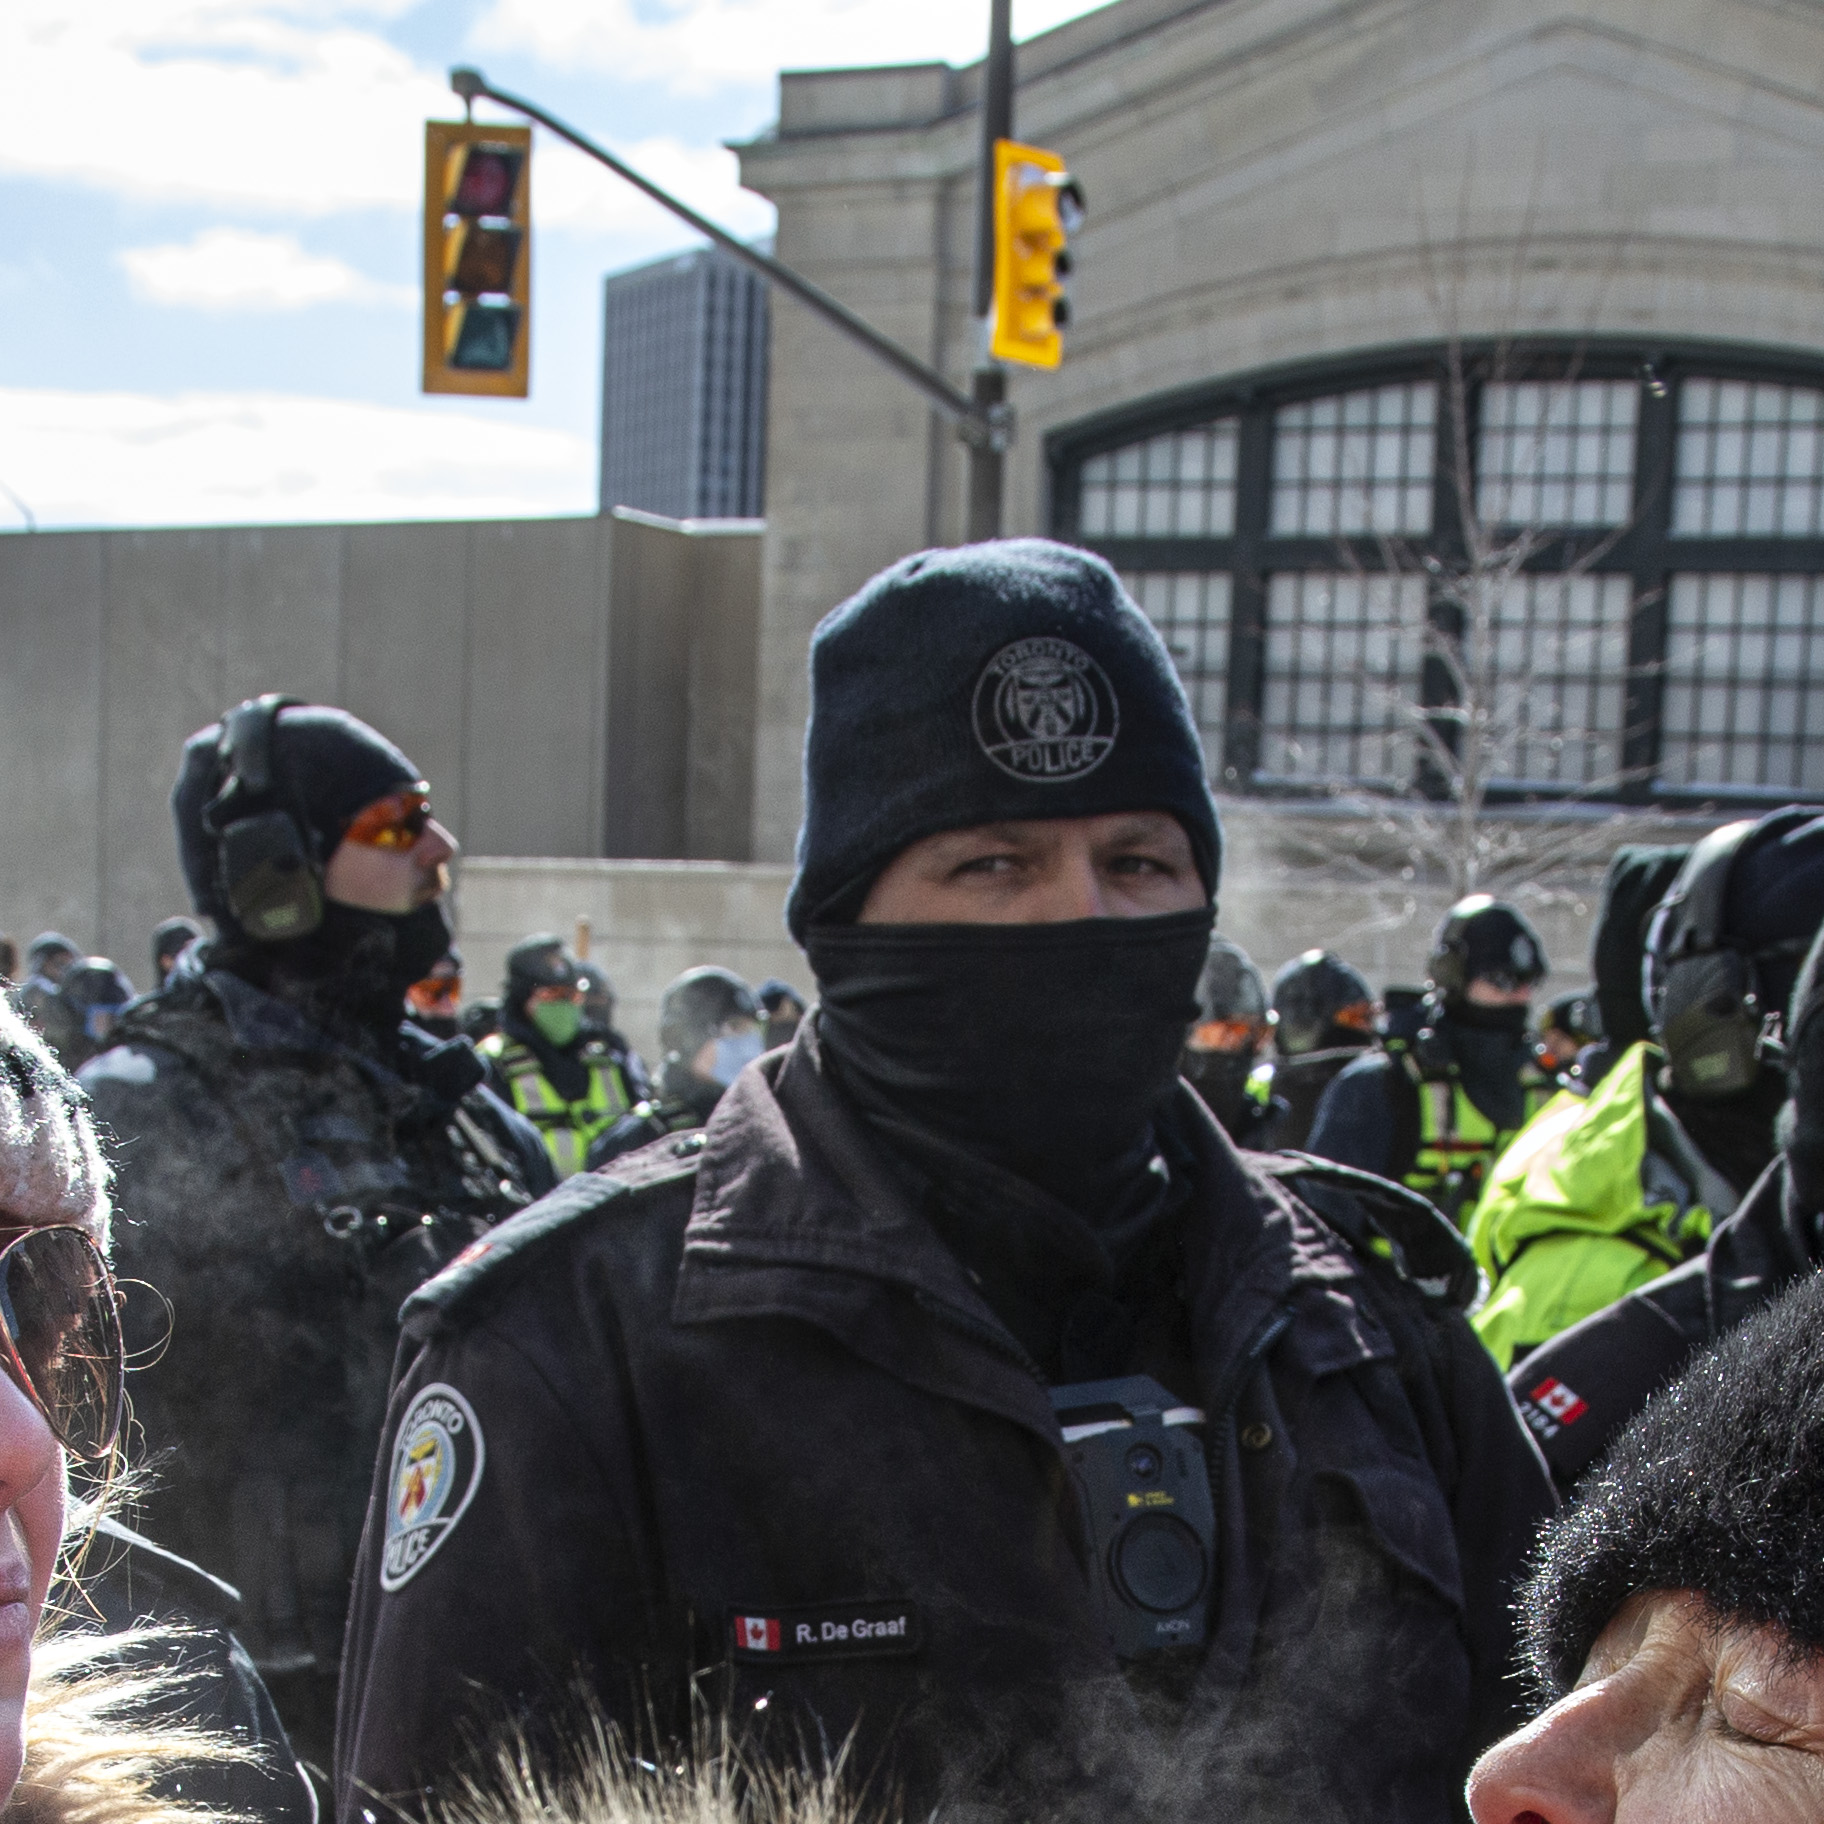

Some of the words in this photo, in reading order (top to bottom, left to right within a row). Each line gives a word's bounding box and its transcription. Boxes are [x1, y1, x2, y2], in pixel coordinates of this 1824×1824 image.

[989, 641, 1090, 675] TORONTO
[1011, 741, 1096, 773] POLICE
[795, 1623, 818, 1644] R.
[821, 1611, 850, 1641] De
[852, 1605, 907, 1639] Graaf
